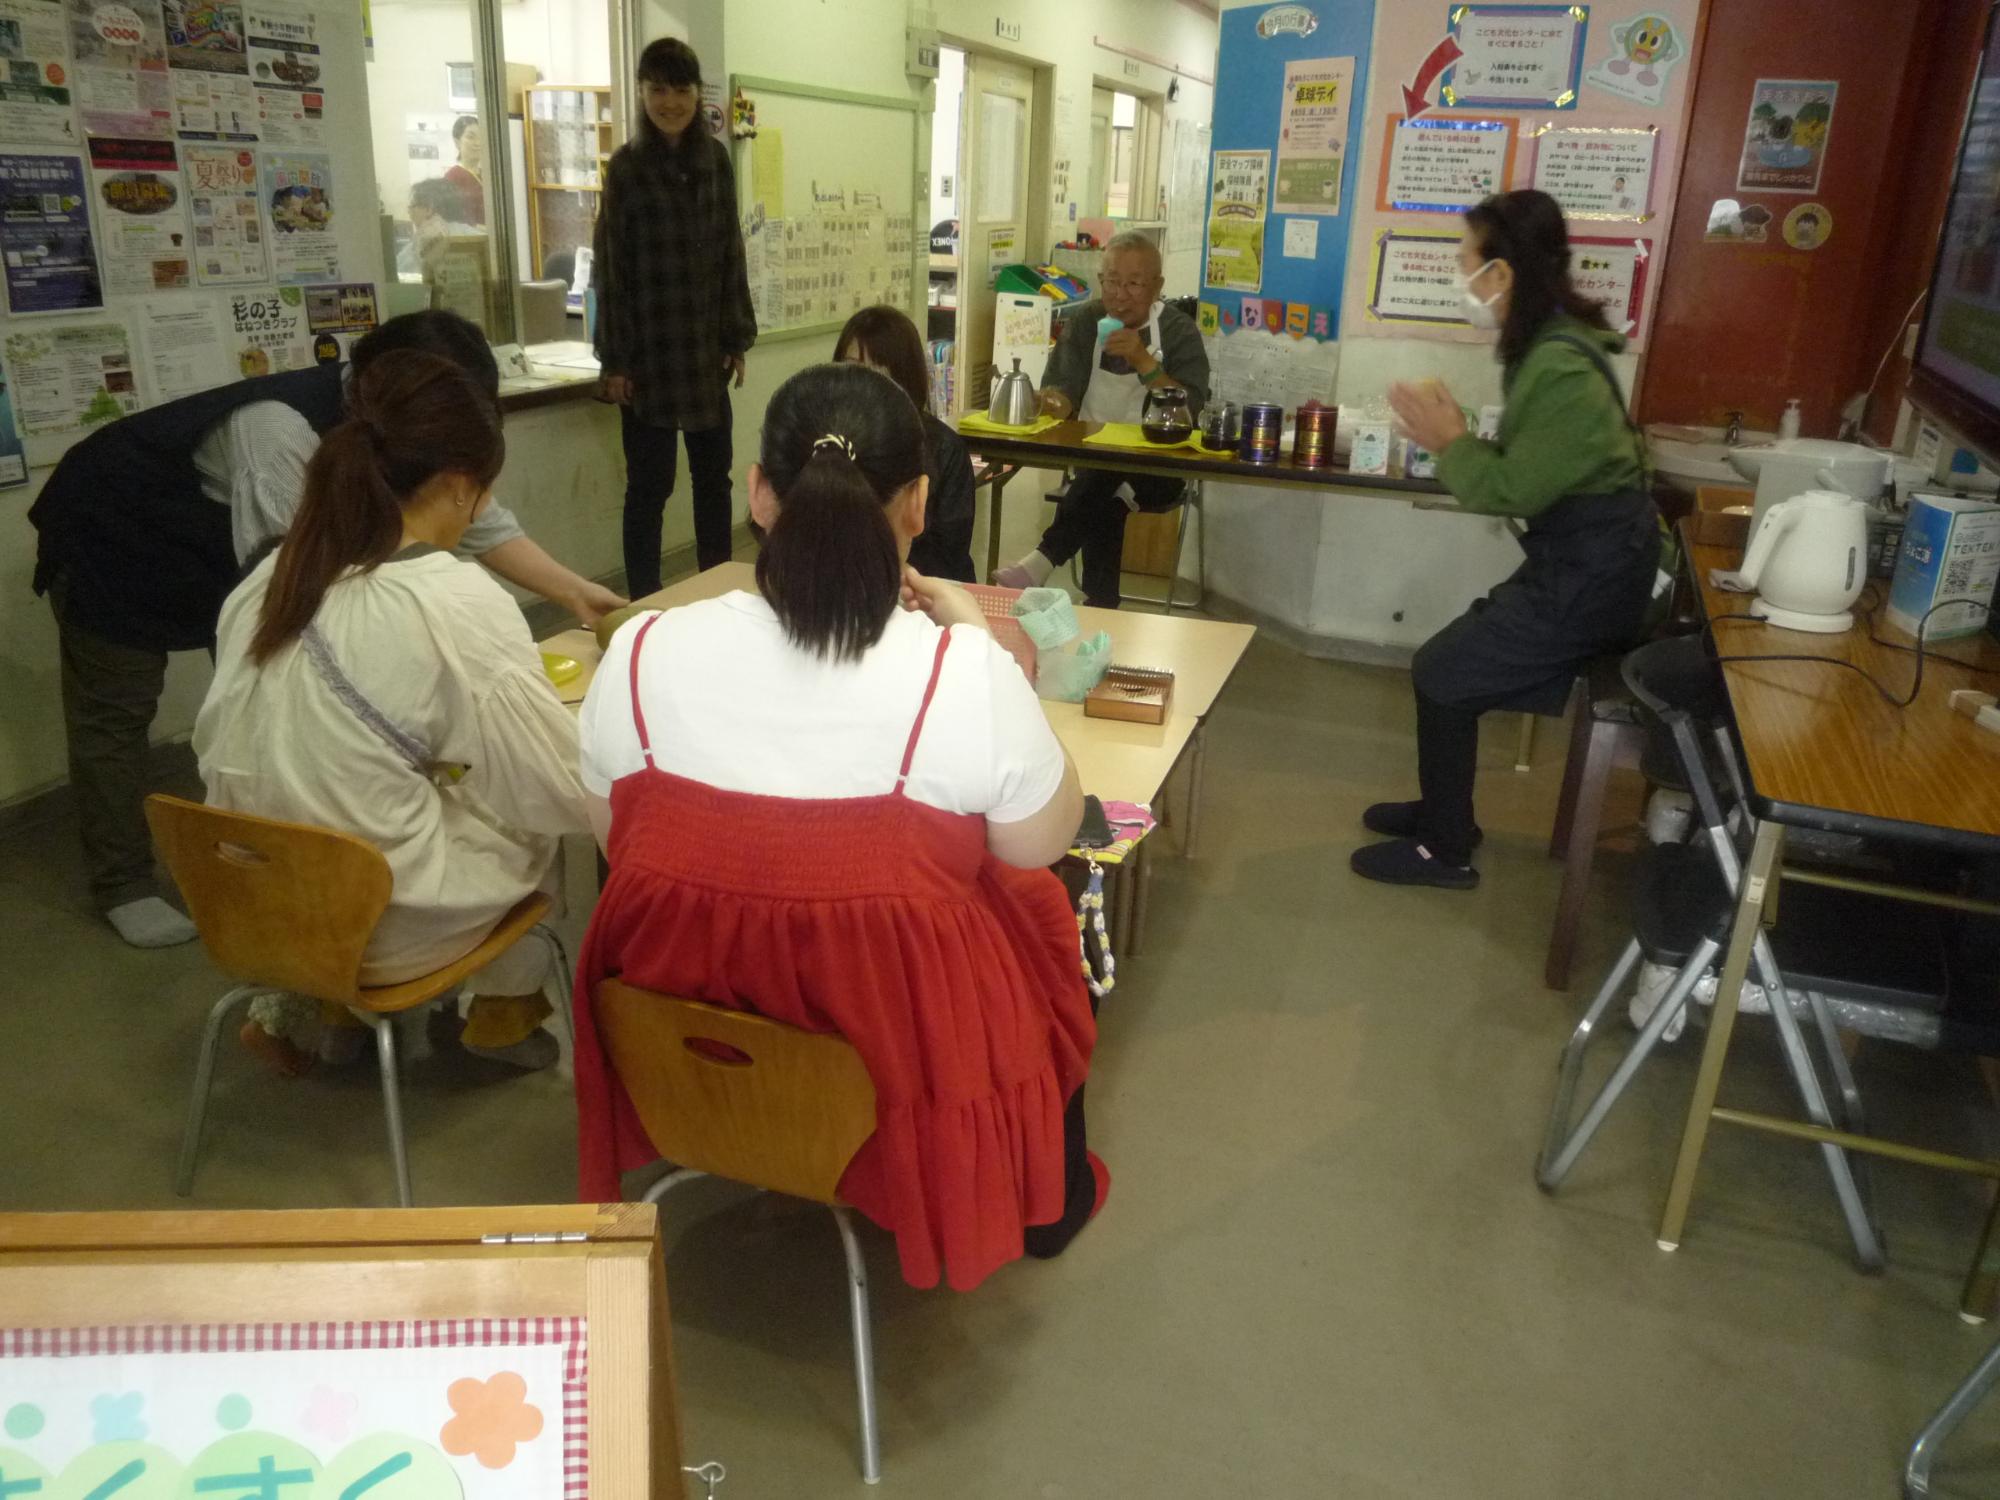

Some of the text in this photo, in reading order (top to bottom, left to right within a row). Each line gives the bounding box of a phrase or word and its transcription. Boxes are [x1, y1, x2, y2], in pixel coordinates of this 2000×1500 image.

[192, 158, 241, 190] 夏祭り
[231, 299, 283, 322] 杉の子
[234, 316, 299, 334] はねつきクラブ
